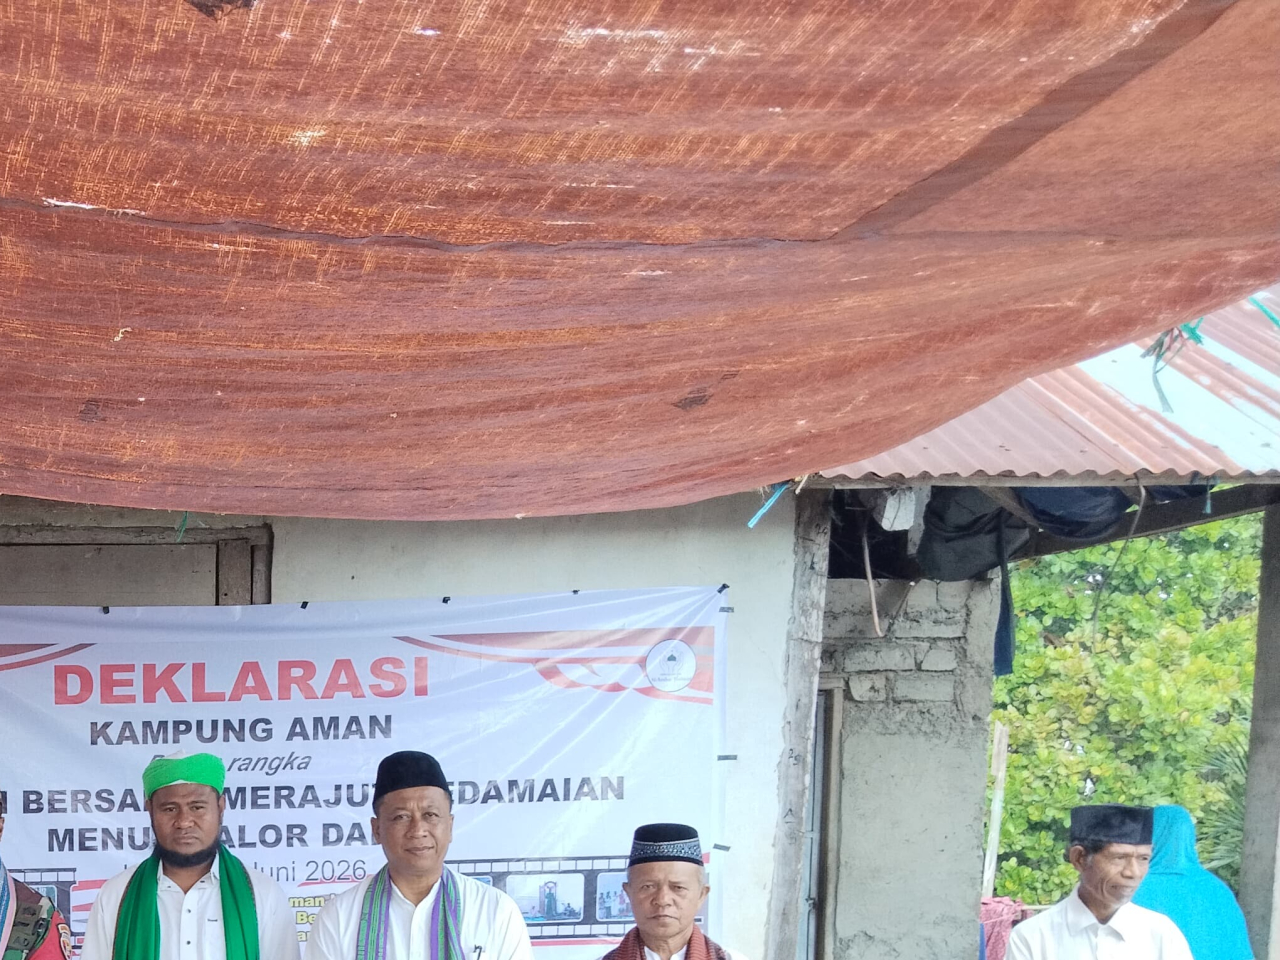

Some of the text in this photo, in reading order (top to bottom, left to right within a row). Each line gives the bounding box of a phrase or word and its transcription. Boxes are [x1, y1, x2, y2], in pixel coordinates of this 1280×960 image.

[53, 656, 428, 705] DEKLARASI
[90, 714, 392, 745] KAMPUNG AMAN
[227, 752, 312, 776] rangka
[23, 788, 150, 814] BERSA
[223, 783, 377, 810] MERAJU
[48, 826, 157, 852] MENU
[305, 859, 366, 882] 2026
